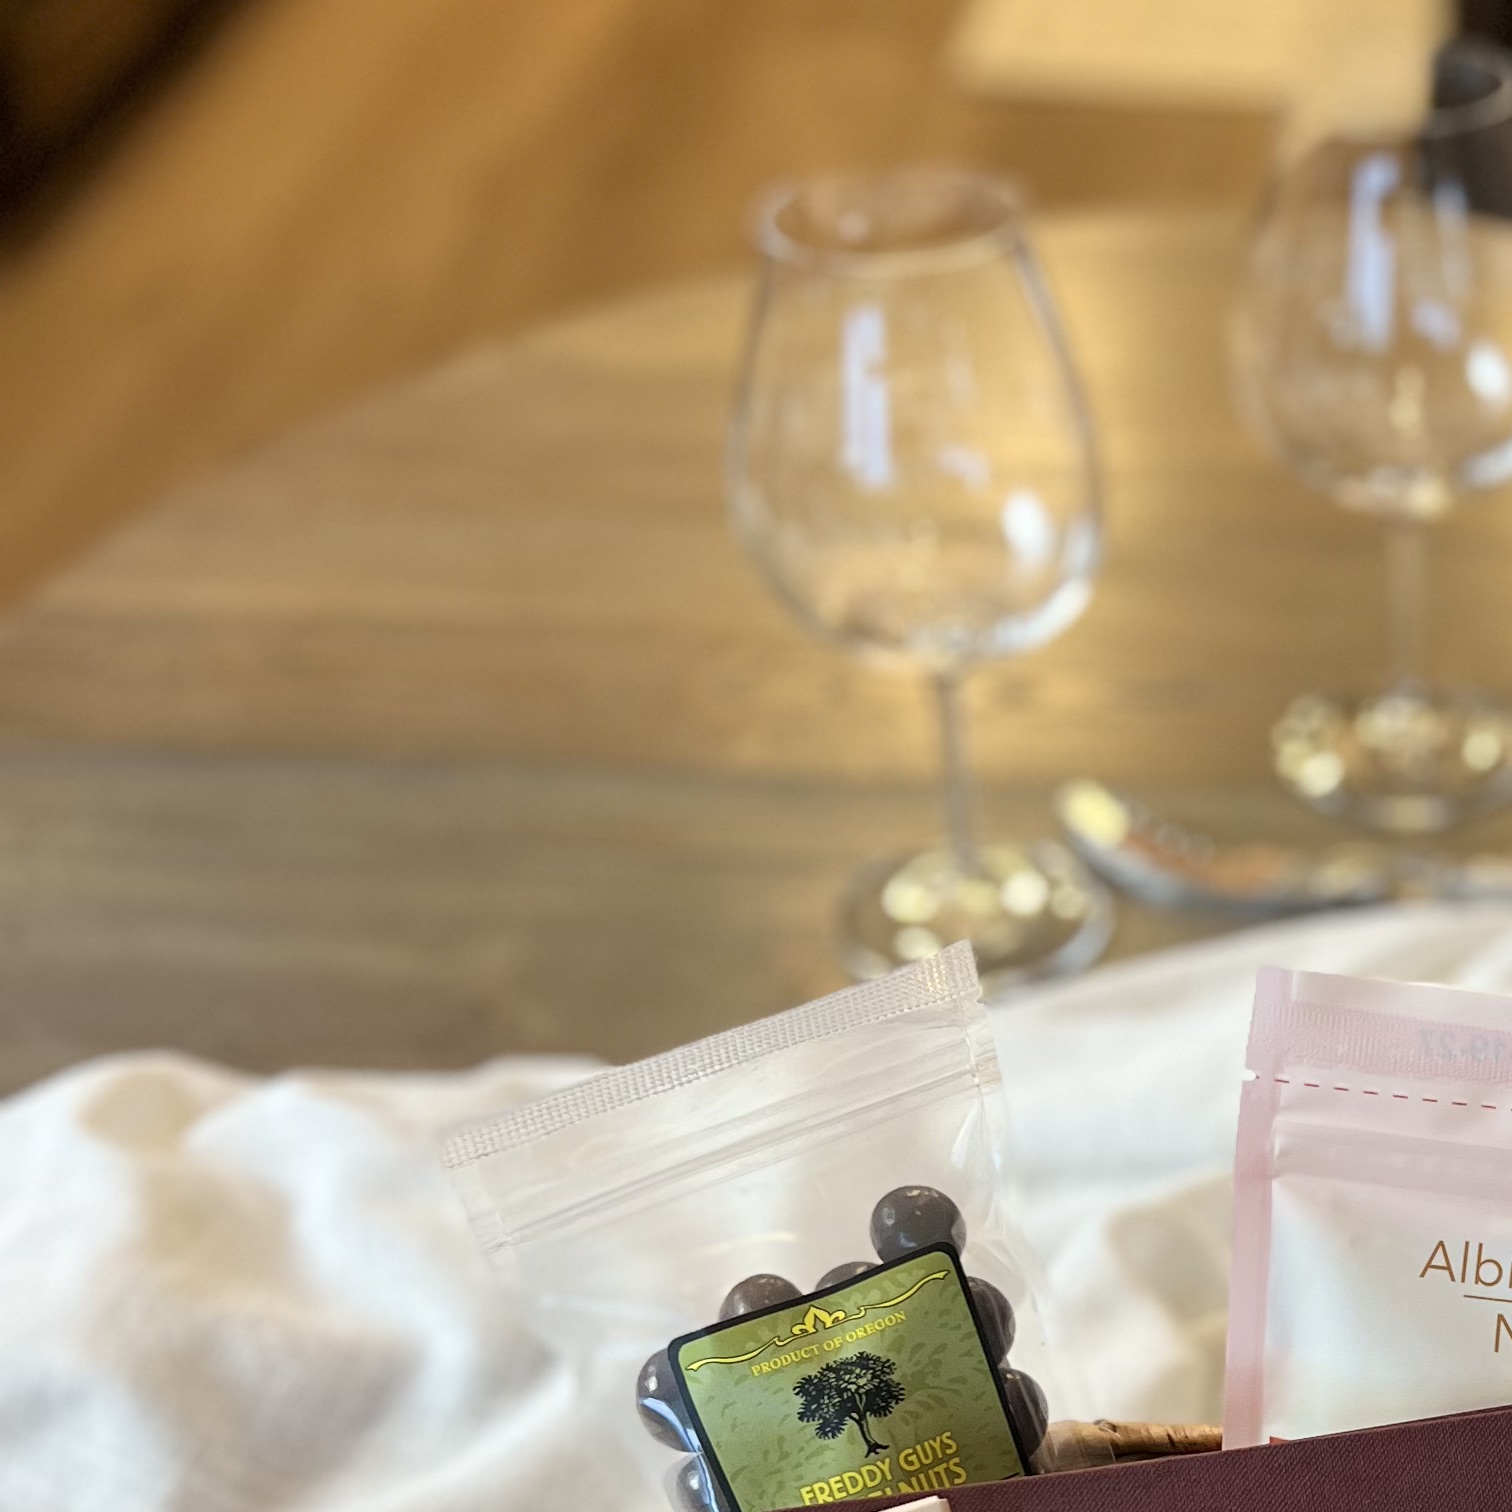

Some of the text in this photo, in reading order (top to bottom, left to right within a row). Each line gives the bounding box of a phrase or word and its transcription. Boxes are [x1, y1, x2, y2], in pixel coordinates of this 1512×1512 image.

[751, 1310, 908, 1377] PRODUCT OF OREGON
[800, 1431, 958, 1506] FREDDY GUYS
